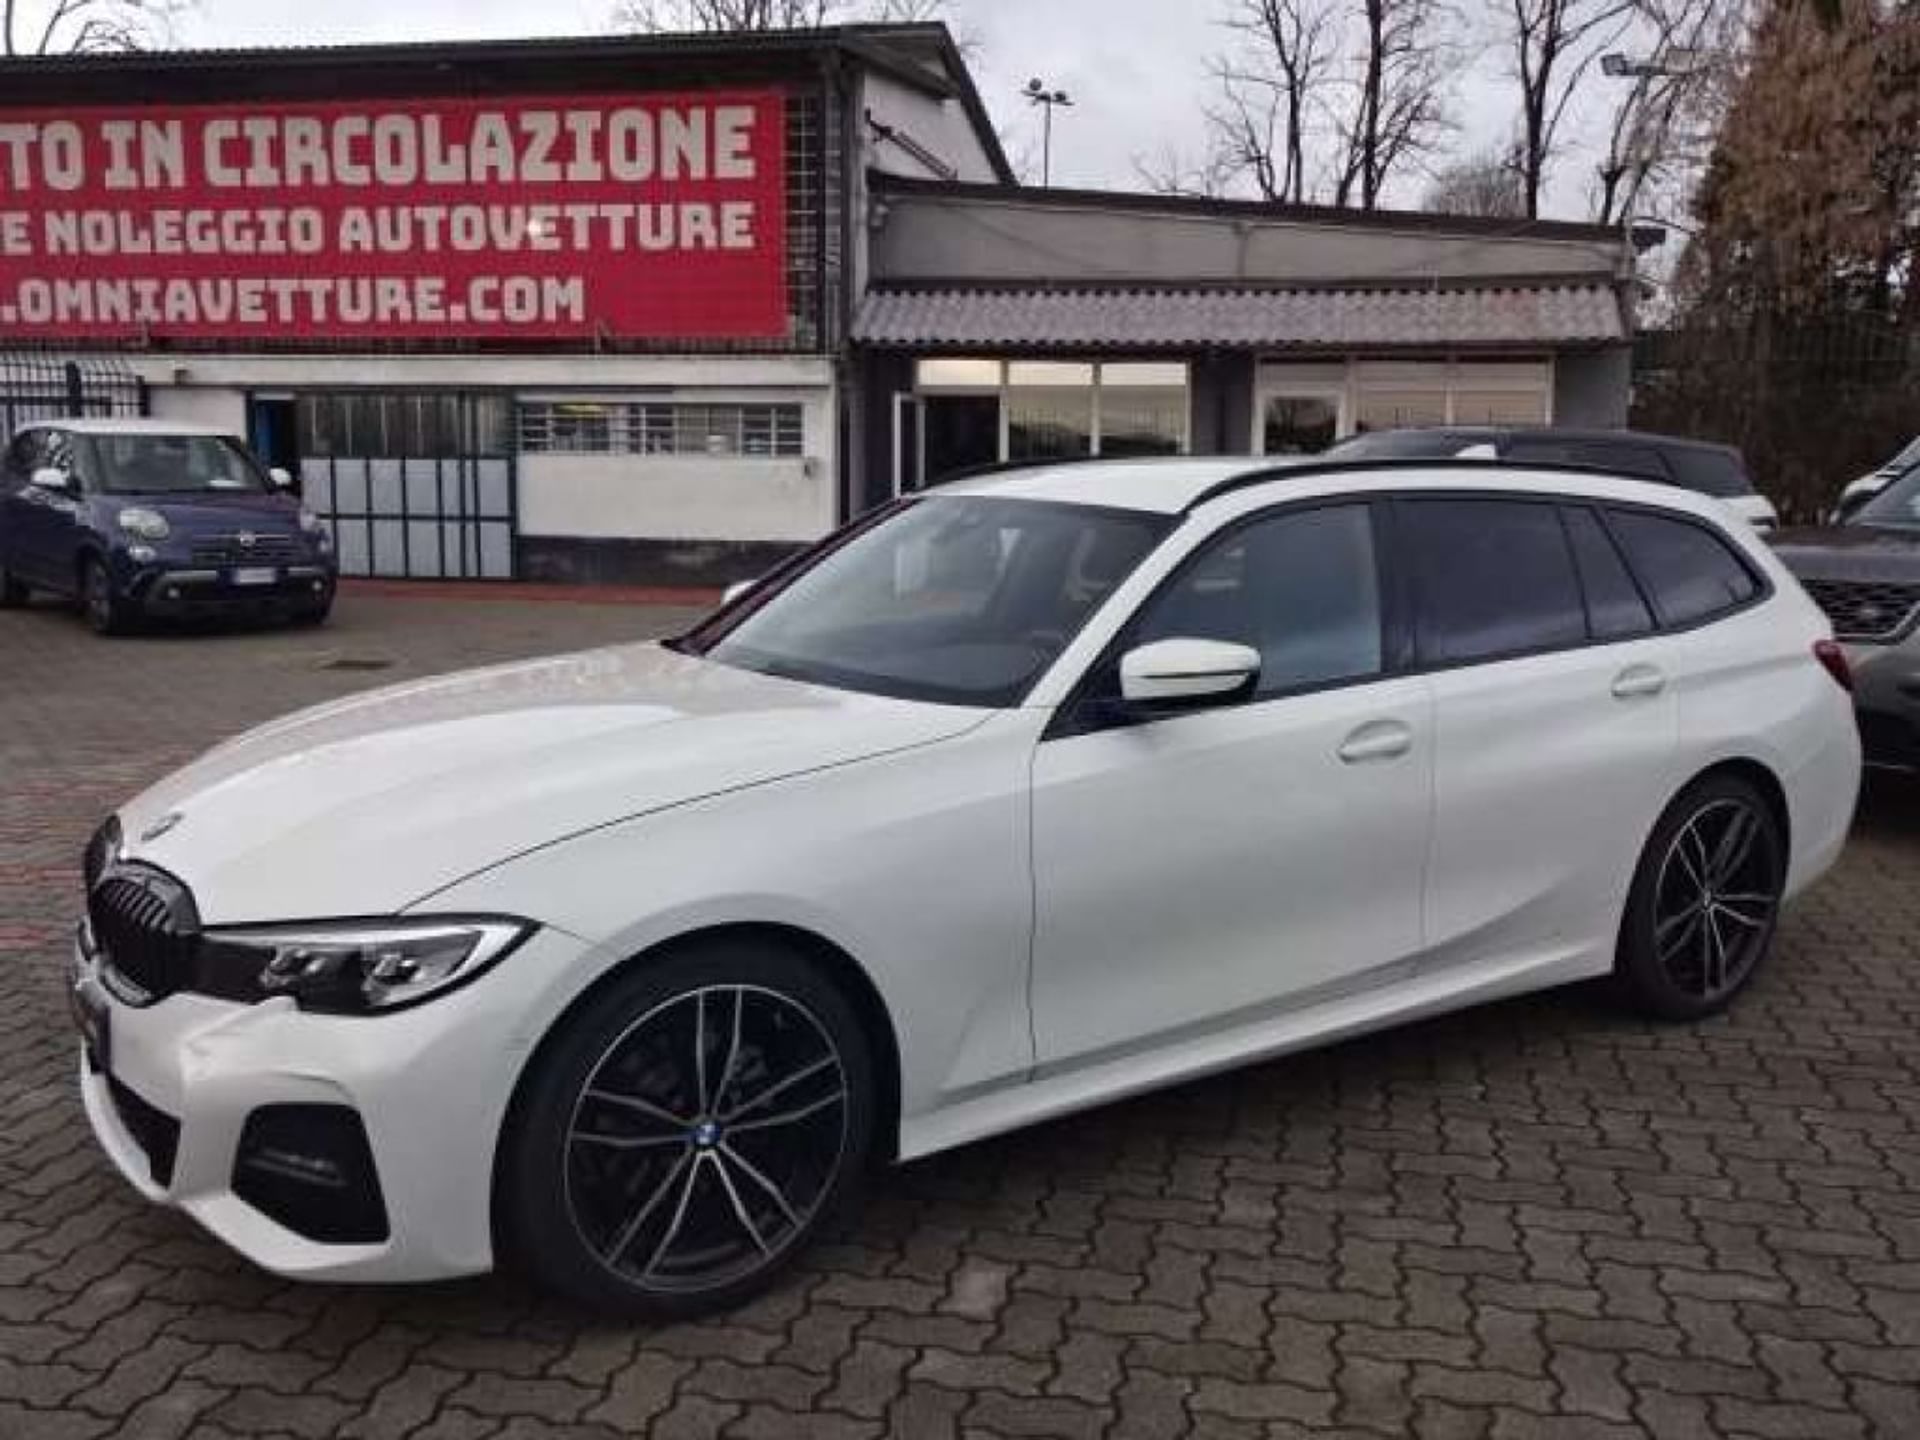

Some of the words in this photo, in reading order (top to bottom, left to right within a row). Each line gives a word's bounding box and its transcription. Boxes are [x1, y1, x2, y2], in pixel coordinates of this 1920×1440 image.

[0, 121, 83, 190] TO
[101, 119, 183, 189] IN
[204, 106, 756, 188] CIRCOLAZIONE
[0, 211, 32, 255] E
[45, 206, 324, 254] NOLEGGIO
[339, 202, 756, 252] AUTOVETTURE
